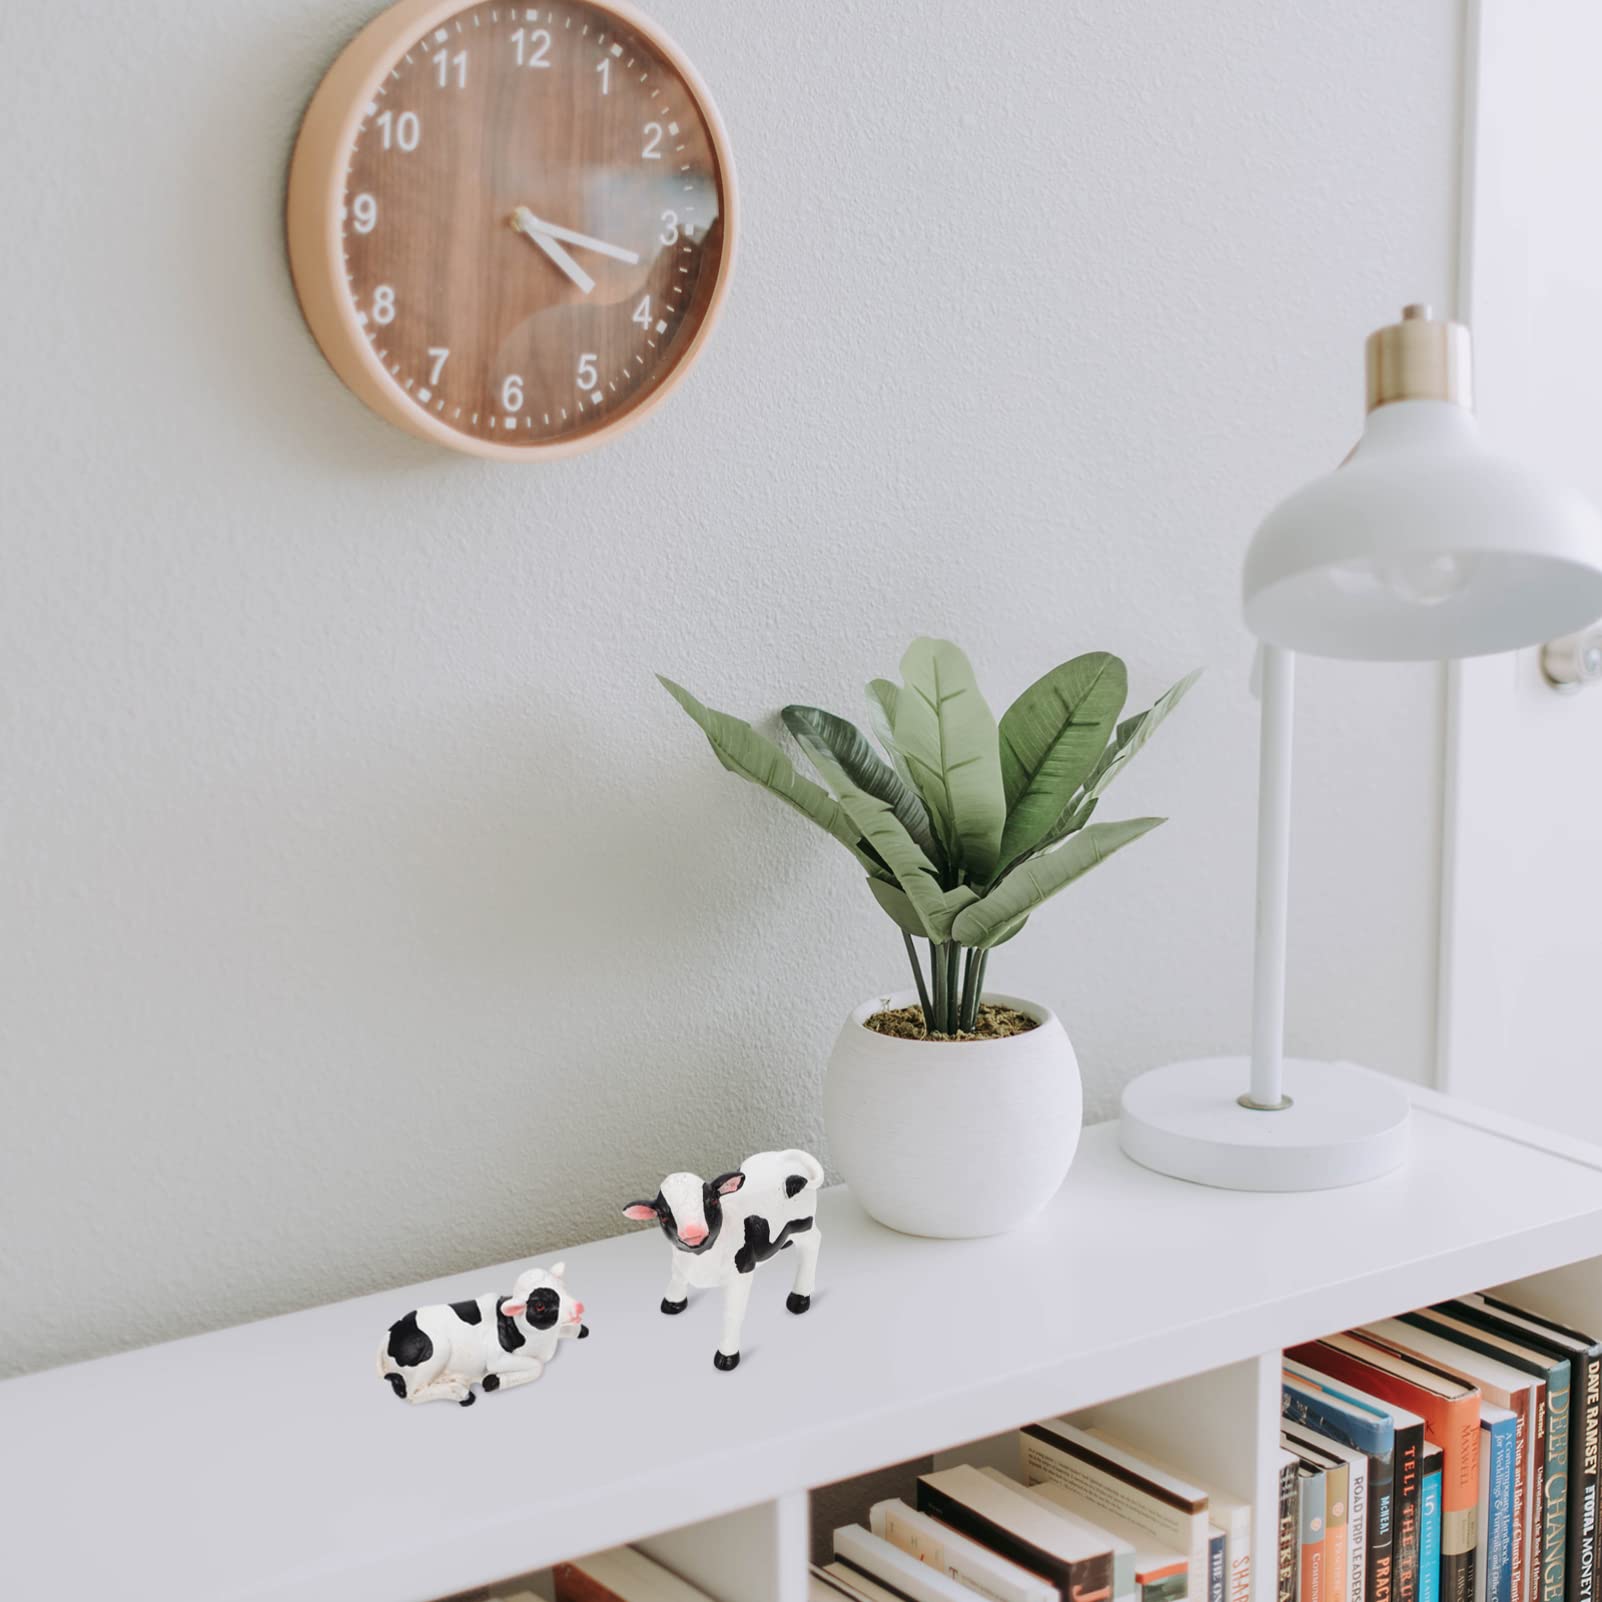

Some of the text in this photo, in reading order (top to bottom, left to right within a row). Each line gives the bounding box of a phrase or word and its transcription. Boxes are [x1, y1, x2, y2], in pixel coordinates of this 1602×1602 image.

[511, 29, 552, 68] 12
[433, 50, 469, 89] 11
[596, 59, 612, 94] 1
[376, 111, 420, 151] 10
[642, 123, 663, 159] 2
[353, 193, 377, 233] 9
[659, 210, 678, 246] 3
[372, 285, 395, 325] 8
[632, 295, 652, 331] 4
[428, 348, 449, 385] 7
[577, 354, 598, 389] 5
[502, 375, 524, 412] 6
[1587, 1361, 1600, 1405] DAVE
[1495, 1434, 1505, 1448] for
[1516, 1414, 1525, 1438] The
[1584, 1406, 1599, 1475] RAMSEY
[1460, 1424, 1471, 1488] MAXWELL
[1515, 1439, 1524, 1466] Nuts
[1493, 1450, 1505, 1499] Weddings
[1501, 1441, 1512, 1513] Contemporary
[1514, 1467, 1523, 1488] and
[1544, 1384, 1570, 1602] DEEP CHANGE
[1353, 1475, 1364, 1513] ROAD
[1423, 1494, 1435, 1516] 5
[1494, 1500, 1503, 1510] &
[1514, 1488, 1523, 1517] Bolts
[1534, 1465, 1544, 1522] Understanding
[1352, 1515, 1363, 1545] TRIP
[1380, 1495, 1391, 1535] McNEAL
[1401, 1445, 1416, 1602] TELL THE TRU
[1493, 1512, 1502, 1552] Funerals
[1513, 1518, 1522, 1528] of
[1583, 1493, 1596, 1536] TOTAL
[1280, 1514, 1292, 1581] LIKE
[1502, 1514, 1510, 1566] Handbook
[1512, 1528, 1522, 1570] Church
[1534, 1537, 1542, 1557] Book
[1492, 1554, 1501, 1570] and
[1580, 1537, 1593, 1596] MONEY
[1456, 1568, 1465, 1595] LAWS
[1491, 1571, 1500, 1594] Other
[1533, 1567, 1541, 1600] Hebrews
